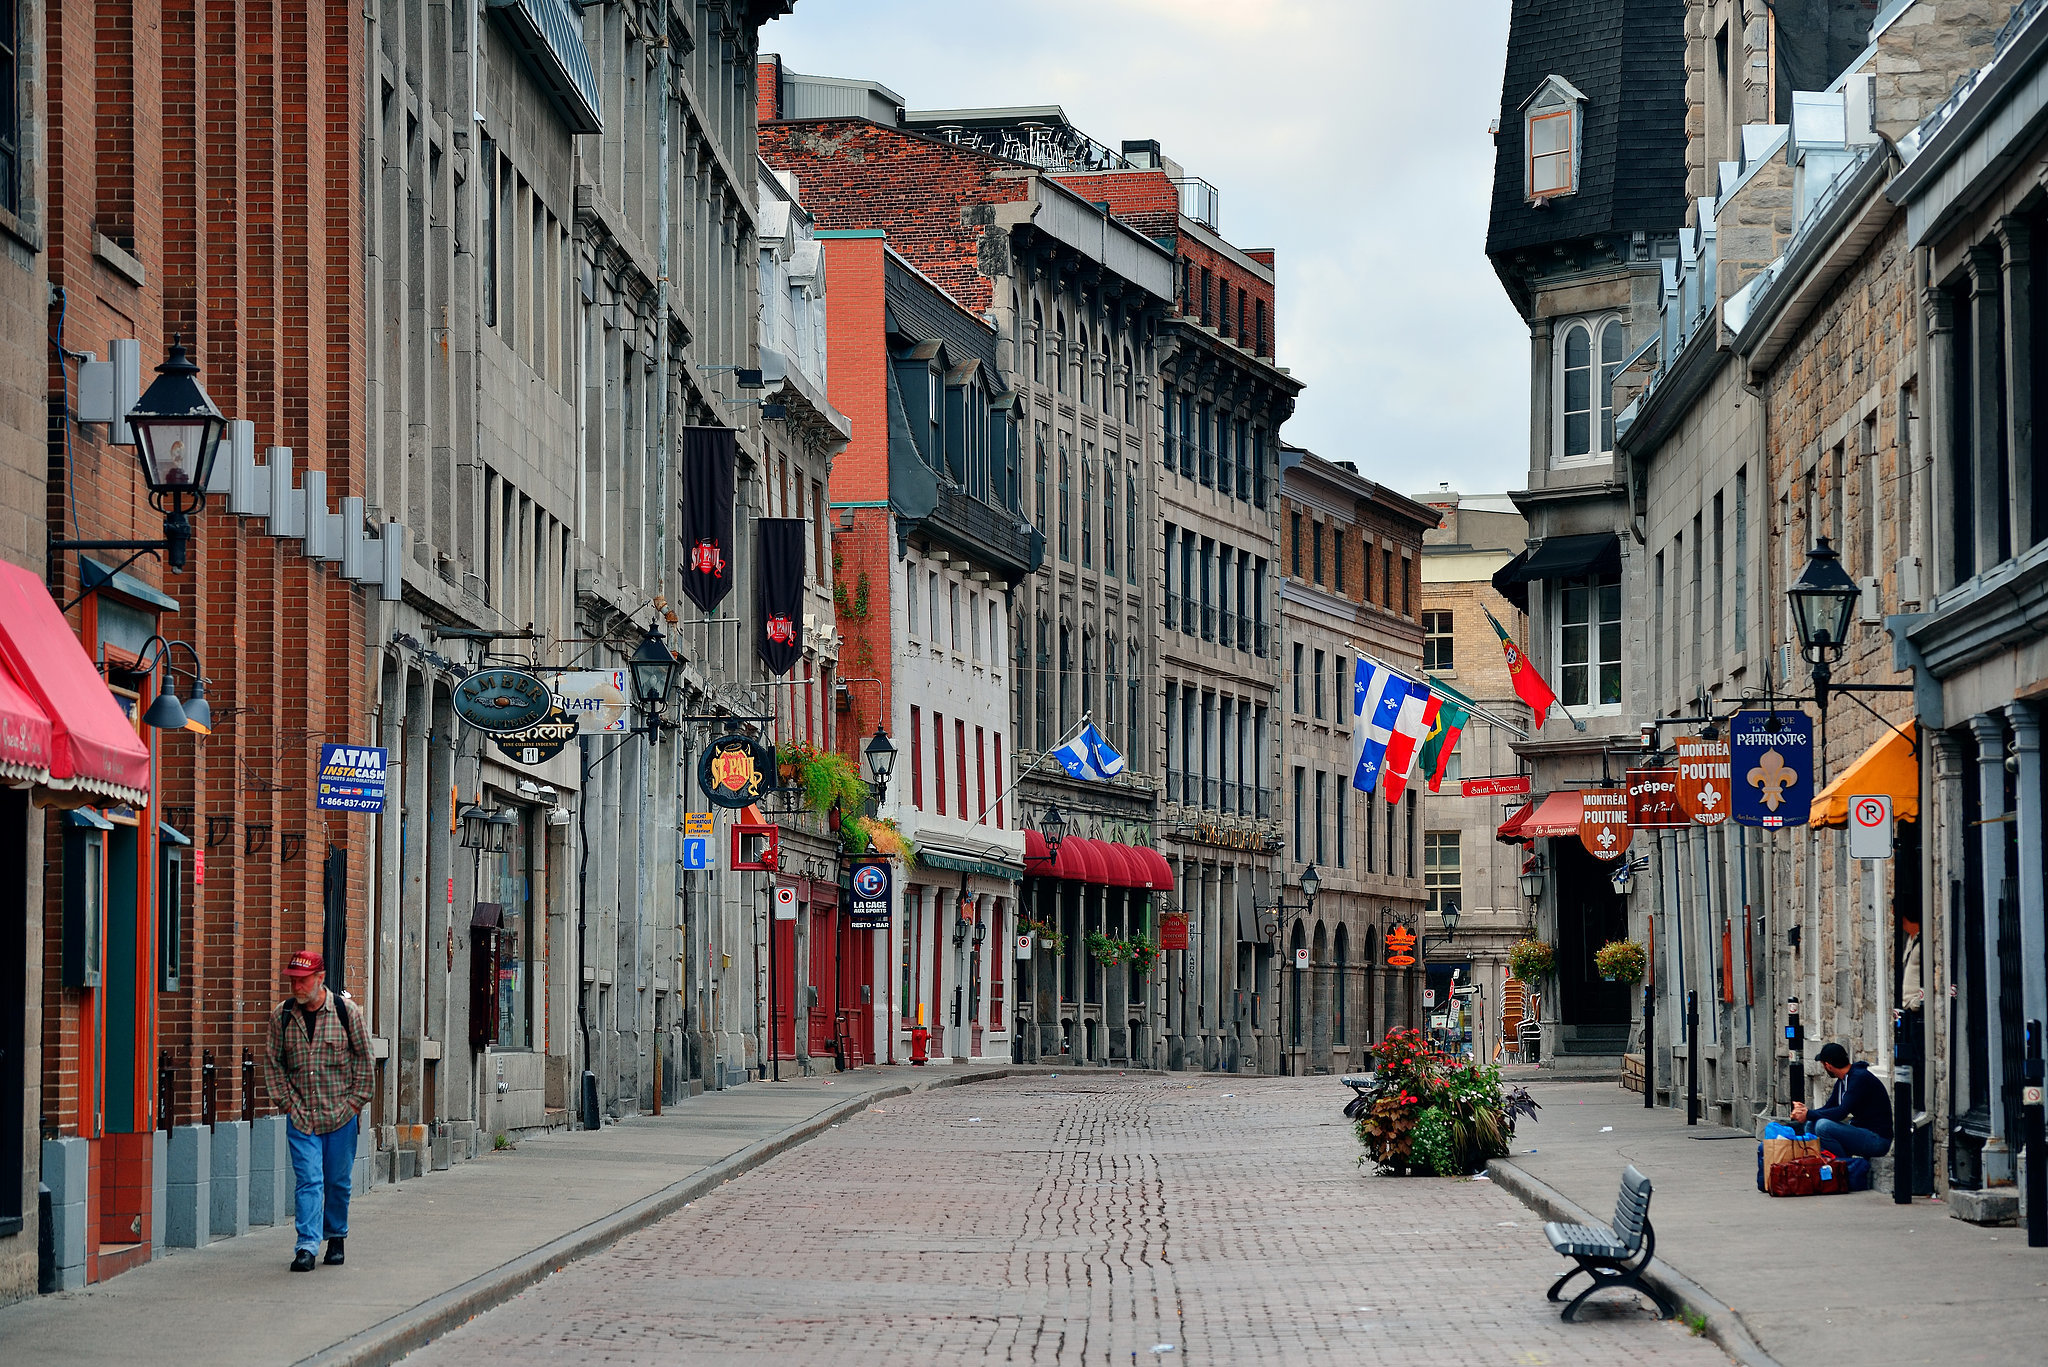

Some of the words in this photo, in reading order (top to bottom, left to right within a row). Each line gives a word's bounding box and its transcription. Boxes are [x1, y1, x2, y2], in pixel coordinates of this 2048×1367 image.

[703, 548, 722, 573] PAUL
[777, 621, 794, 642] PAUL
[463, 674, 543, 703] AMBER
[464, 708, 540, 728] BIJOUTERIE
[1736, 733, 1807, 746] PATRIOTE
[1679, 740, 1730, 757] MONTRÉA
[329, 748, 381, 769] ATM
[728, 756, 758, 790] PAUL
[1681, 763, 1731, 780] POUTIN
[346, 777, 385, 785] AUTOMATIQUES
[1470, 783, 1521, 794] Saint-Vincent
[1629, 780, 1677, 796] crêper
[320, 796, 381, 809] 1-866-837-0777
[1584, 810, 1628, 824] POUTINE
[1694, 812, 1726, 824] RESTO-BAR
[1866, 805, 1877, 820] P
[1534, 825, 1543, 835] La
[1545, 826, 1577, 836] Sauvagine
[1593, 850, 1619, 860] RESTO-BAR
[853, 901, 865, 909] LA
[866, 901, 887, 909] CAGE
